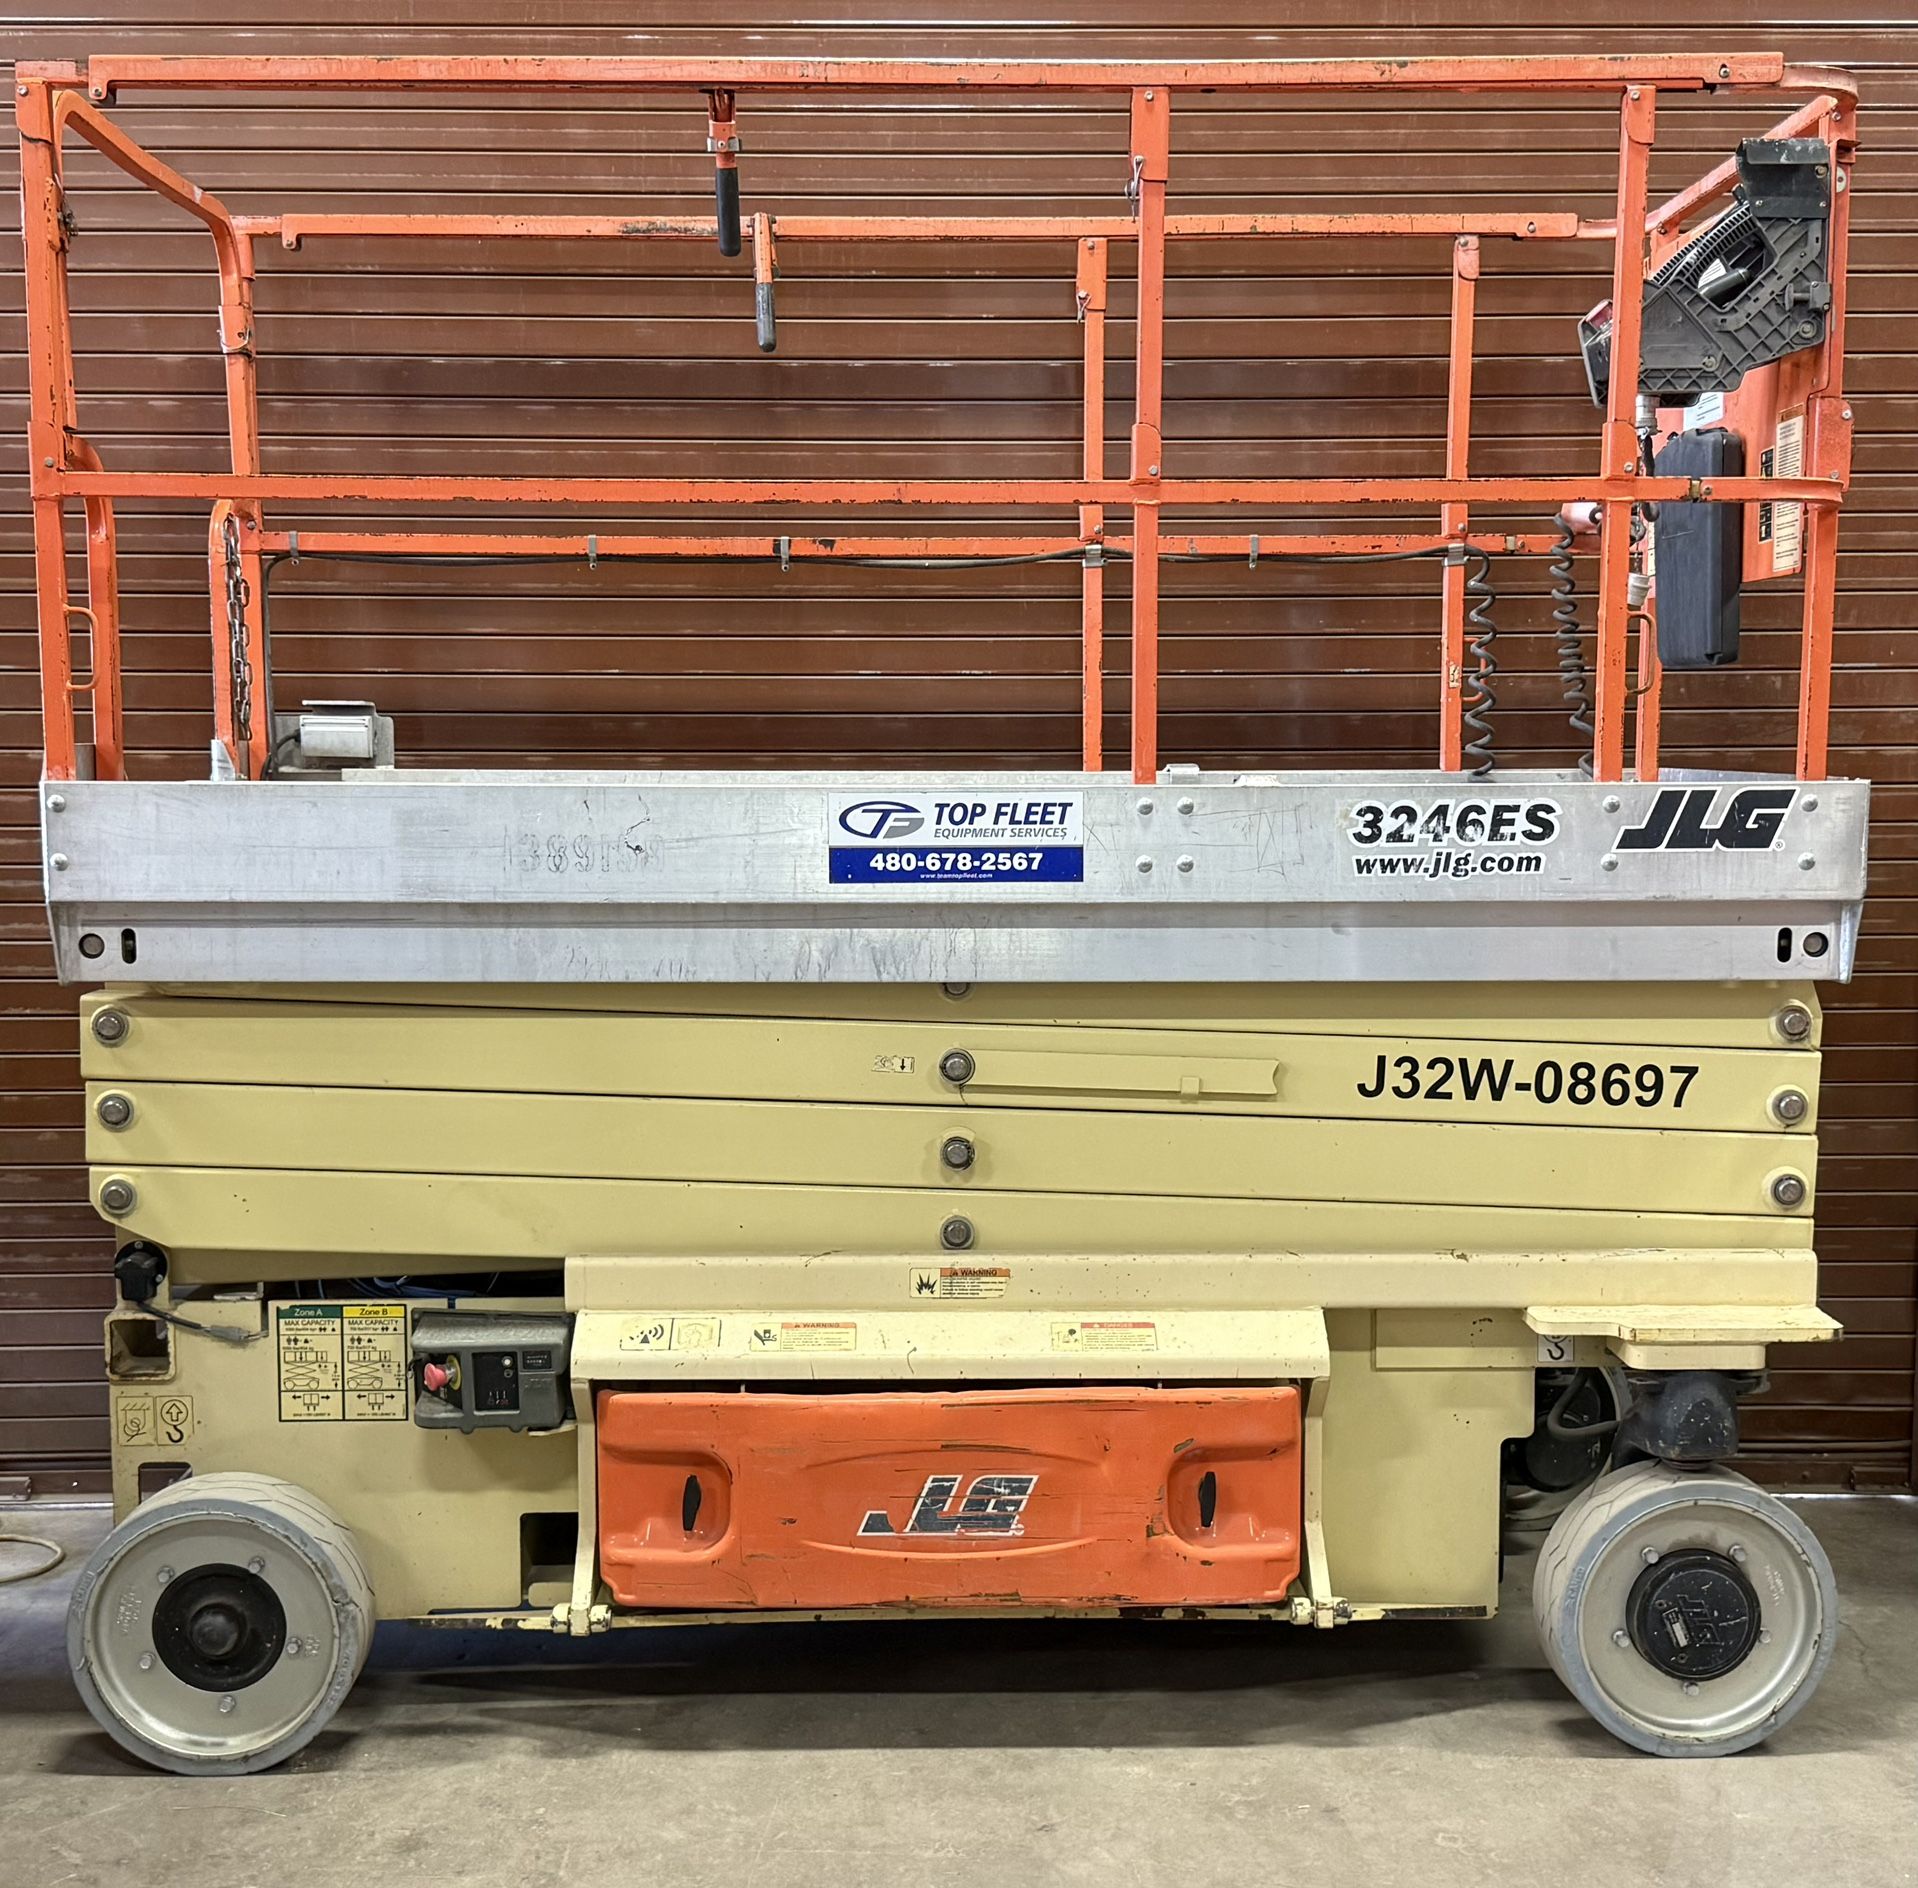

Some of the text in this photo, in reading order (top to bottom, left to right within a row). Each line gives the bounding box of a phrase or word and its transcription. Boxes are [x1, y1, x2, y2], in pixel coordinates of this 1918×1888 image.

[934, 802, 1073, 826] TOP FLEET
[1352, 803, 1557, 844] 3246ES
[1616, 790, 1796, 849] JLG
[934, 827, 1068, 839] EQUIPMENT SERVICES
[869, 853, 1043, 871] 480-678-2567
[1355, 851, 1542, 879] www.jlg.com
[1357, 1055, 1699, 1108] J32W-08697
[294, 1308, 323, 1316] Zone A
[359, 1308, 388, 1316] Zone B
